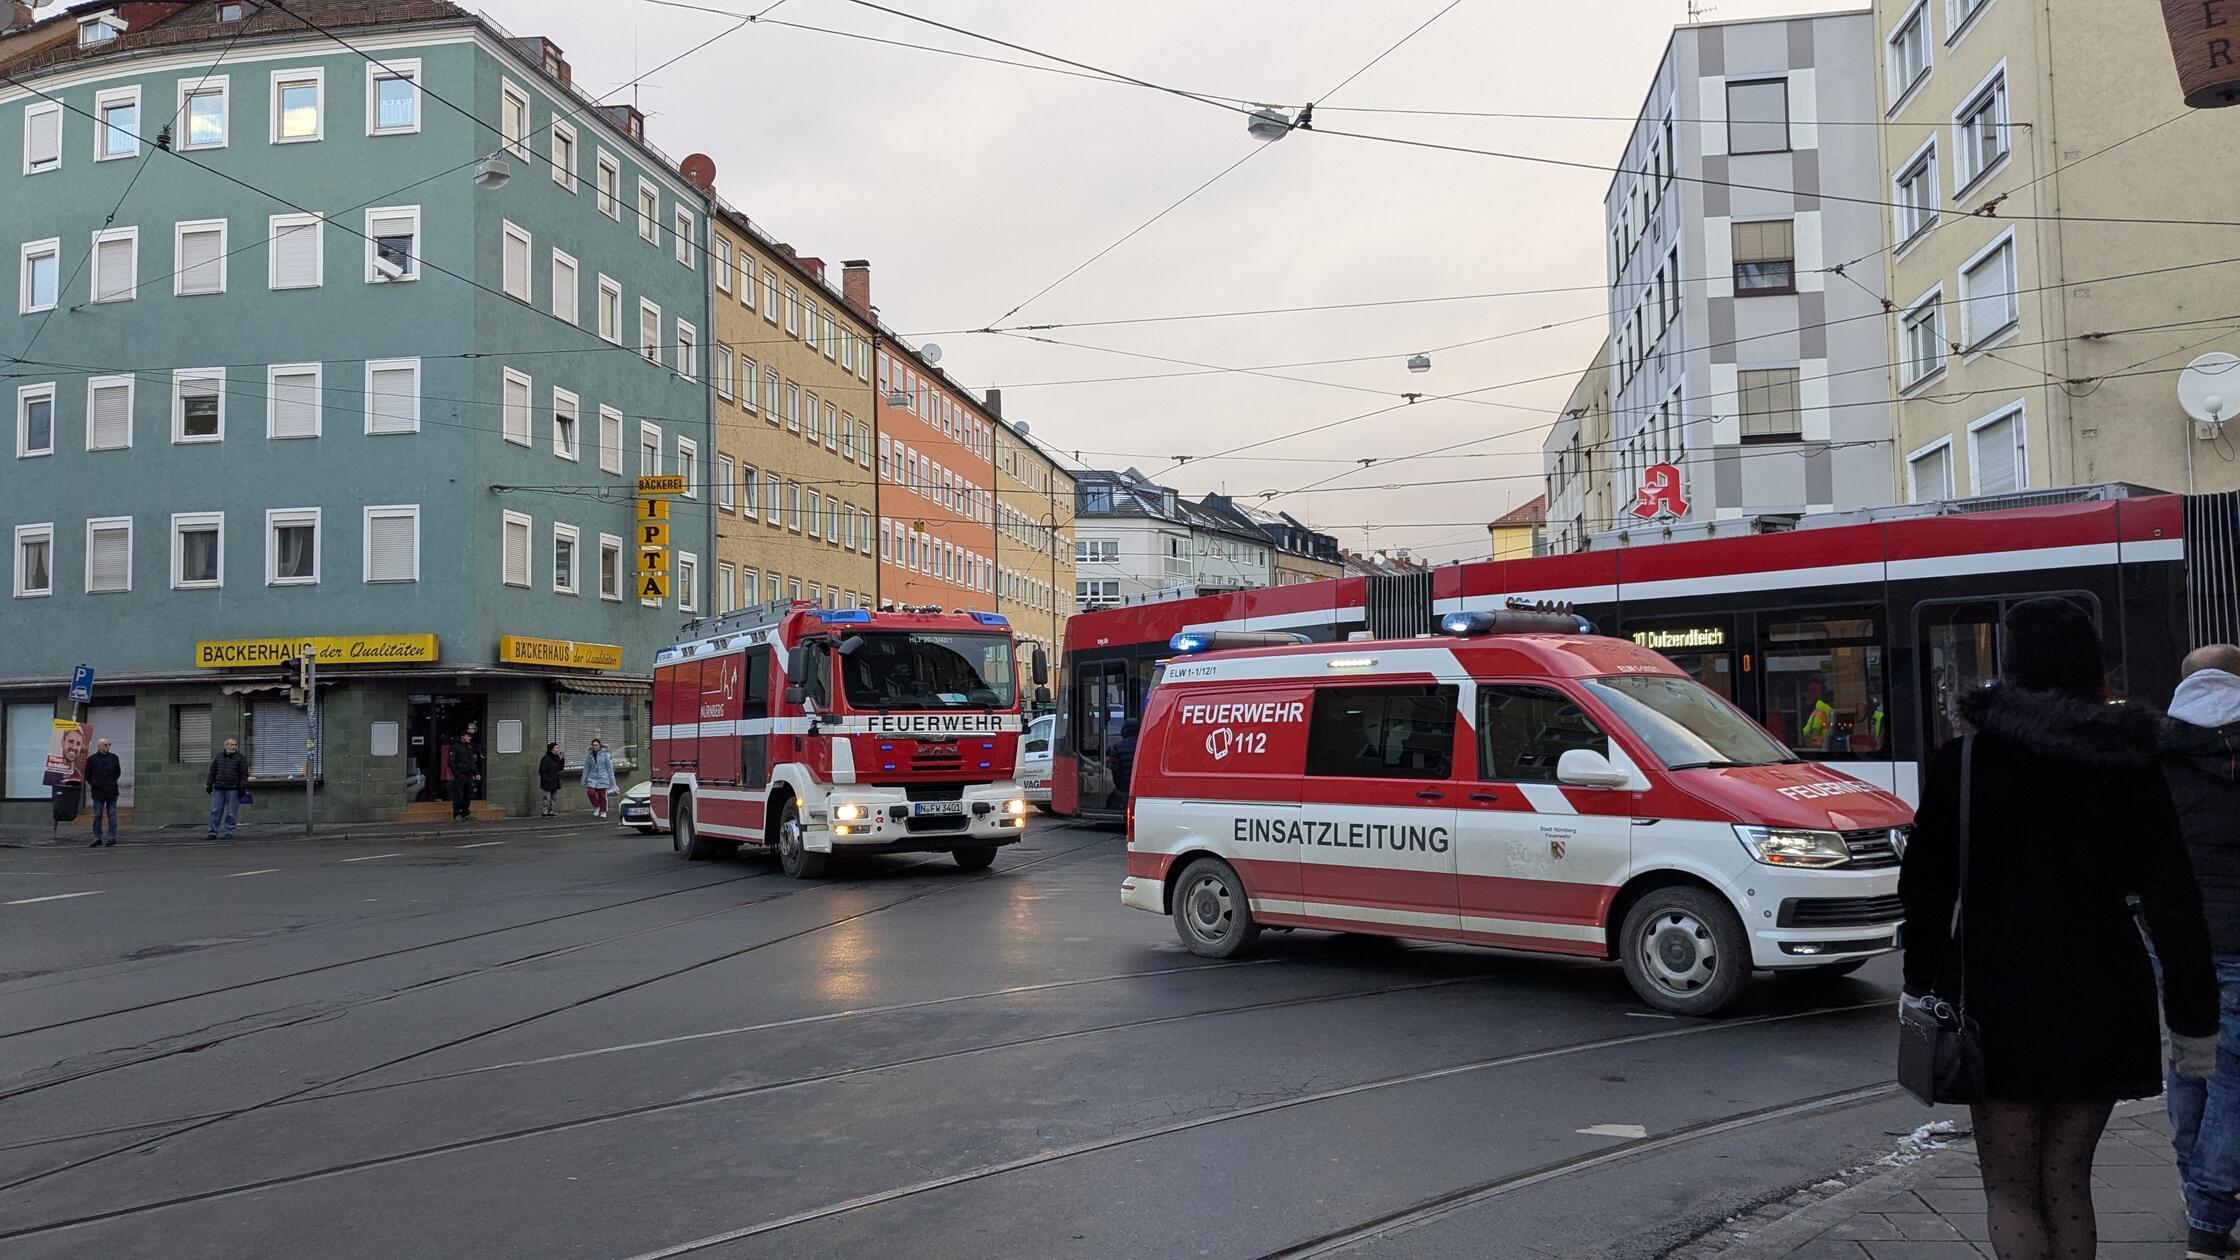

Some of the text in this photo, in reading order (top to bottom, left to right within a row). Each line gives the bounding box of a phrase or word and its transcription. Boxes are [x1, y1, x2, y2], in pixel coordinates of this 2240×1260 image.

[640, 478, 682, 490] BÄCKEREI
[1649, 628, 1724, 648] Dutzendteich
[320, 644, 342, 658] der
[350, 641, 425, 659] Qualitäten
[515, 641, 569, 662] BÄCKERHAUS
[573, 648, 583, 663] der
[76, 668, 86, 682] P
[701, 702, 724, 718] NÜRNBERG
[1182, 702, 1304, 724] FEUERWEHR
[868, 716, 1003, 732] FEUERWEHR
[1235, 732, 1267, 753] 112
[1024, 780, 1039, 789] VAG
[1776, 781, 1884, 801] FEUERWE
[1234, 818, 1449, 853] EINSATZLEITUNG
